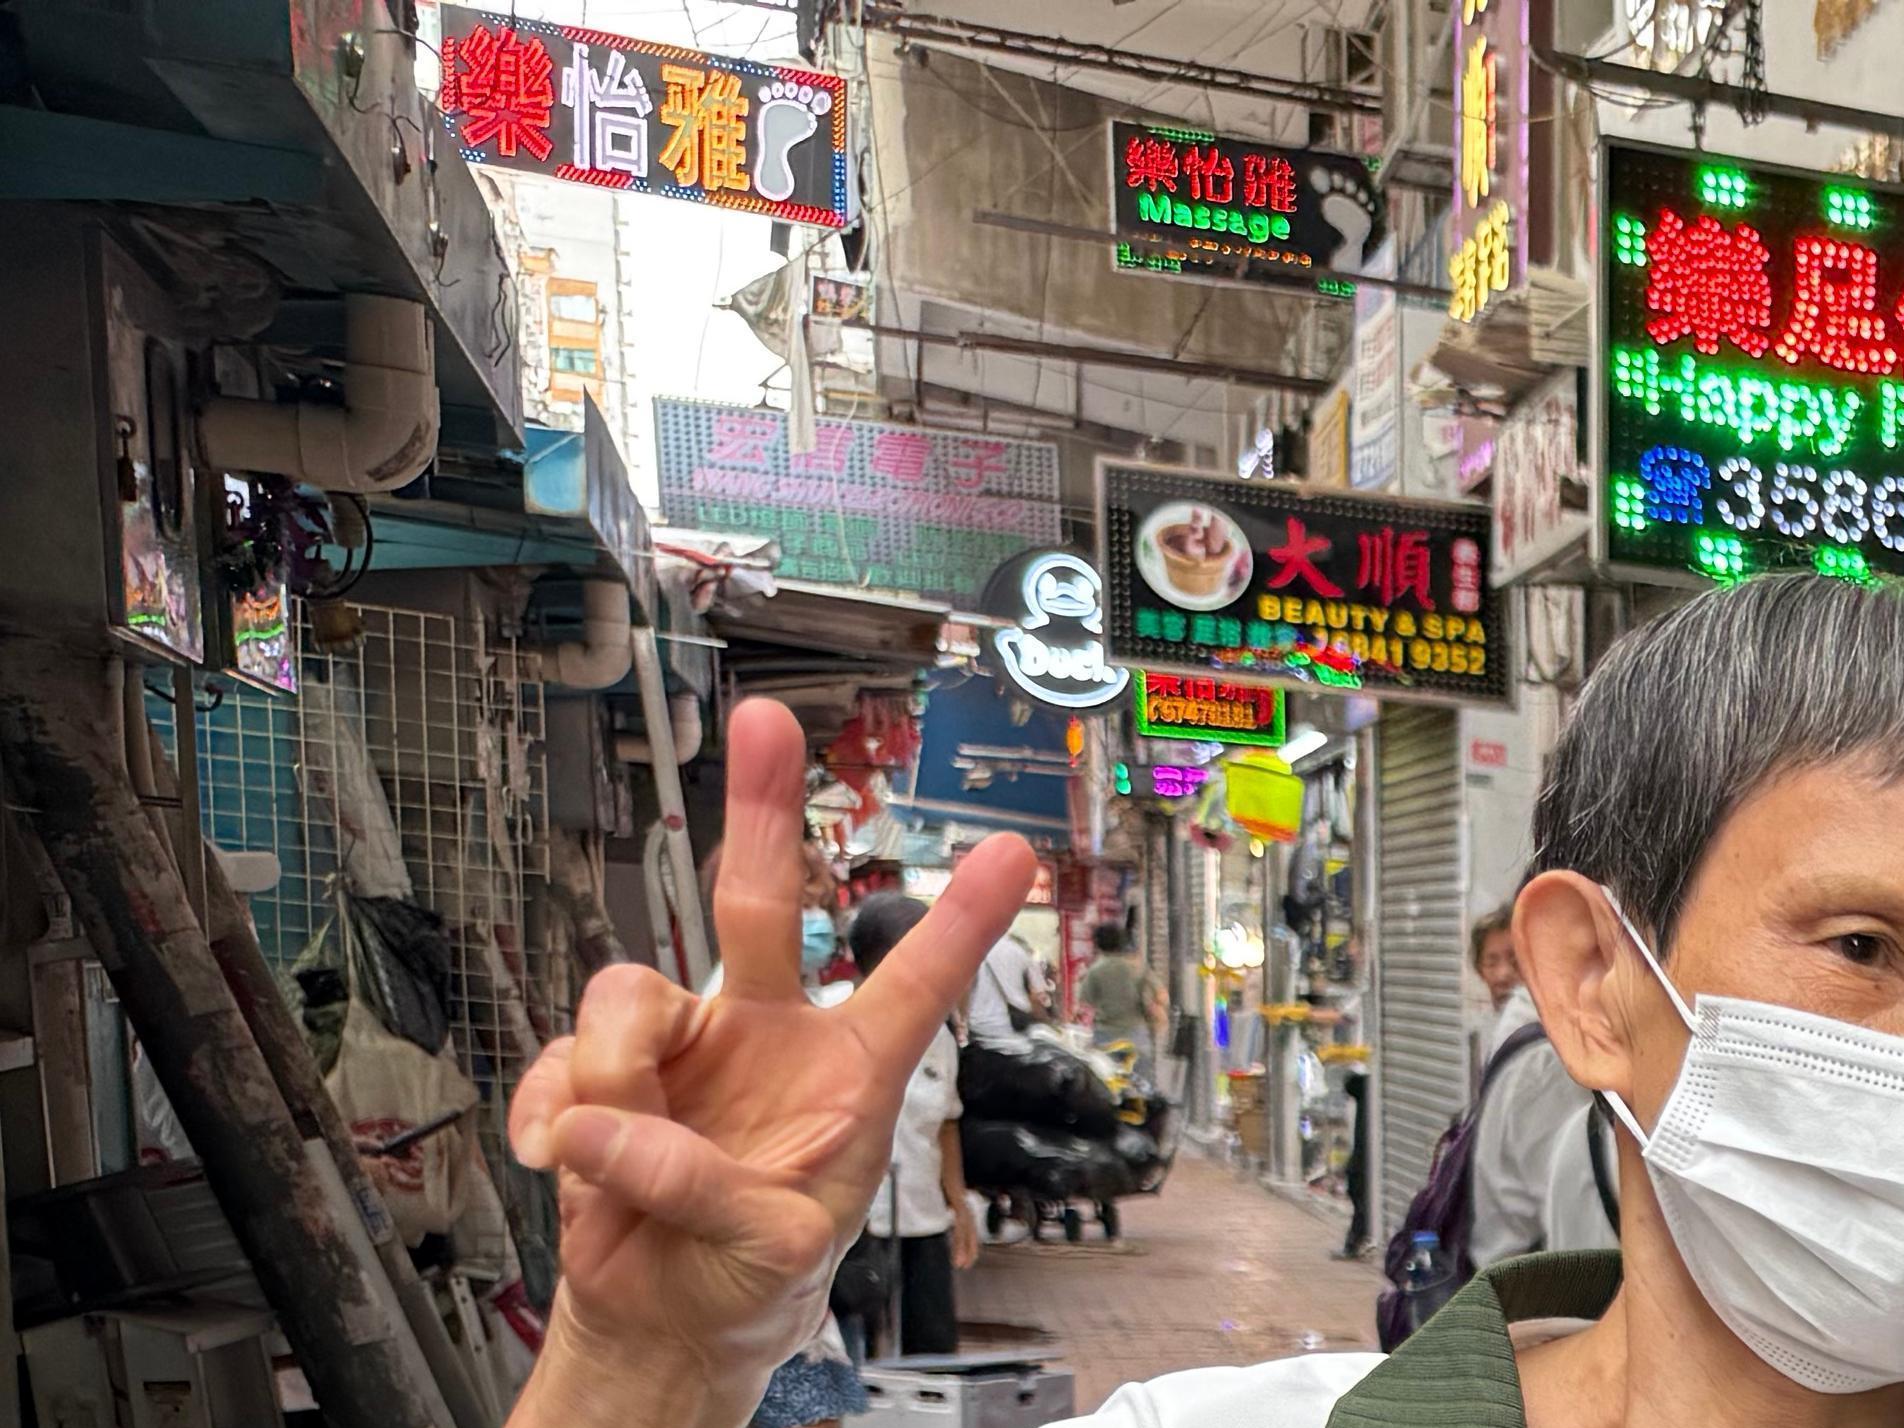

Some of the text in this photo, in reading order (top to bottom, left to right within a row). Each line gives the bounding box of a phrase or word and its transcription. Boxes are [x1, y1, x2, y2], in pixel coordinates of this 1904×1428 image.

[457, 24, 751, 192] 樂怡雅
[1125, 136, 1298, 213] 樂怡雅
[1139, 192, 1291, 243] Massage
[1640, 347, 1861, 457] Happy
[1266, 515, 1437, 612] 大順
[1258, 594, 1388, 632] BEAUTY
[1395, 609, 1417, 637] &
[1422, 612, 1486, 644] SPA
